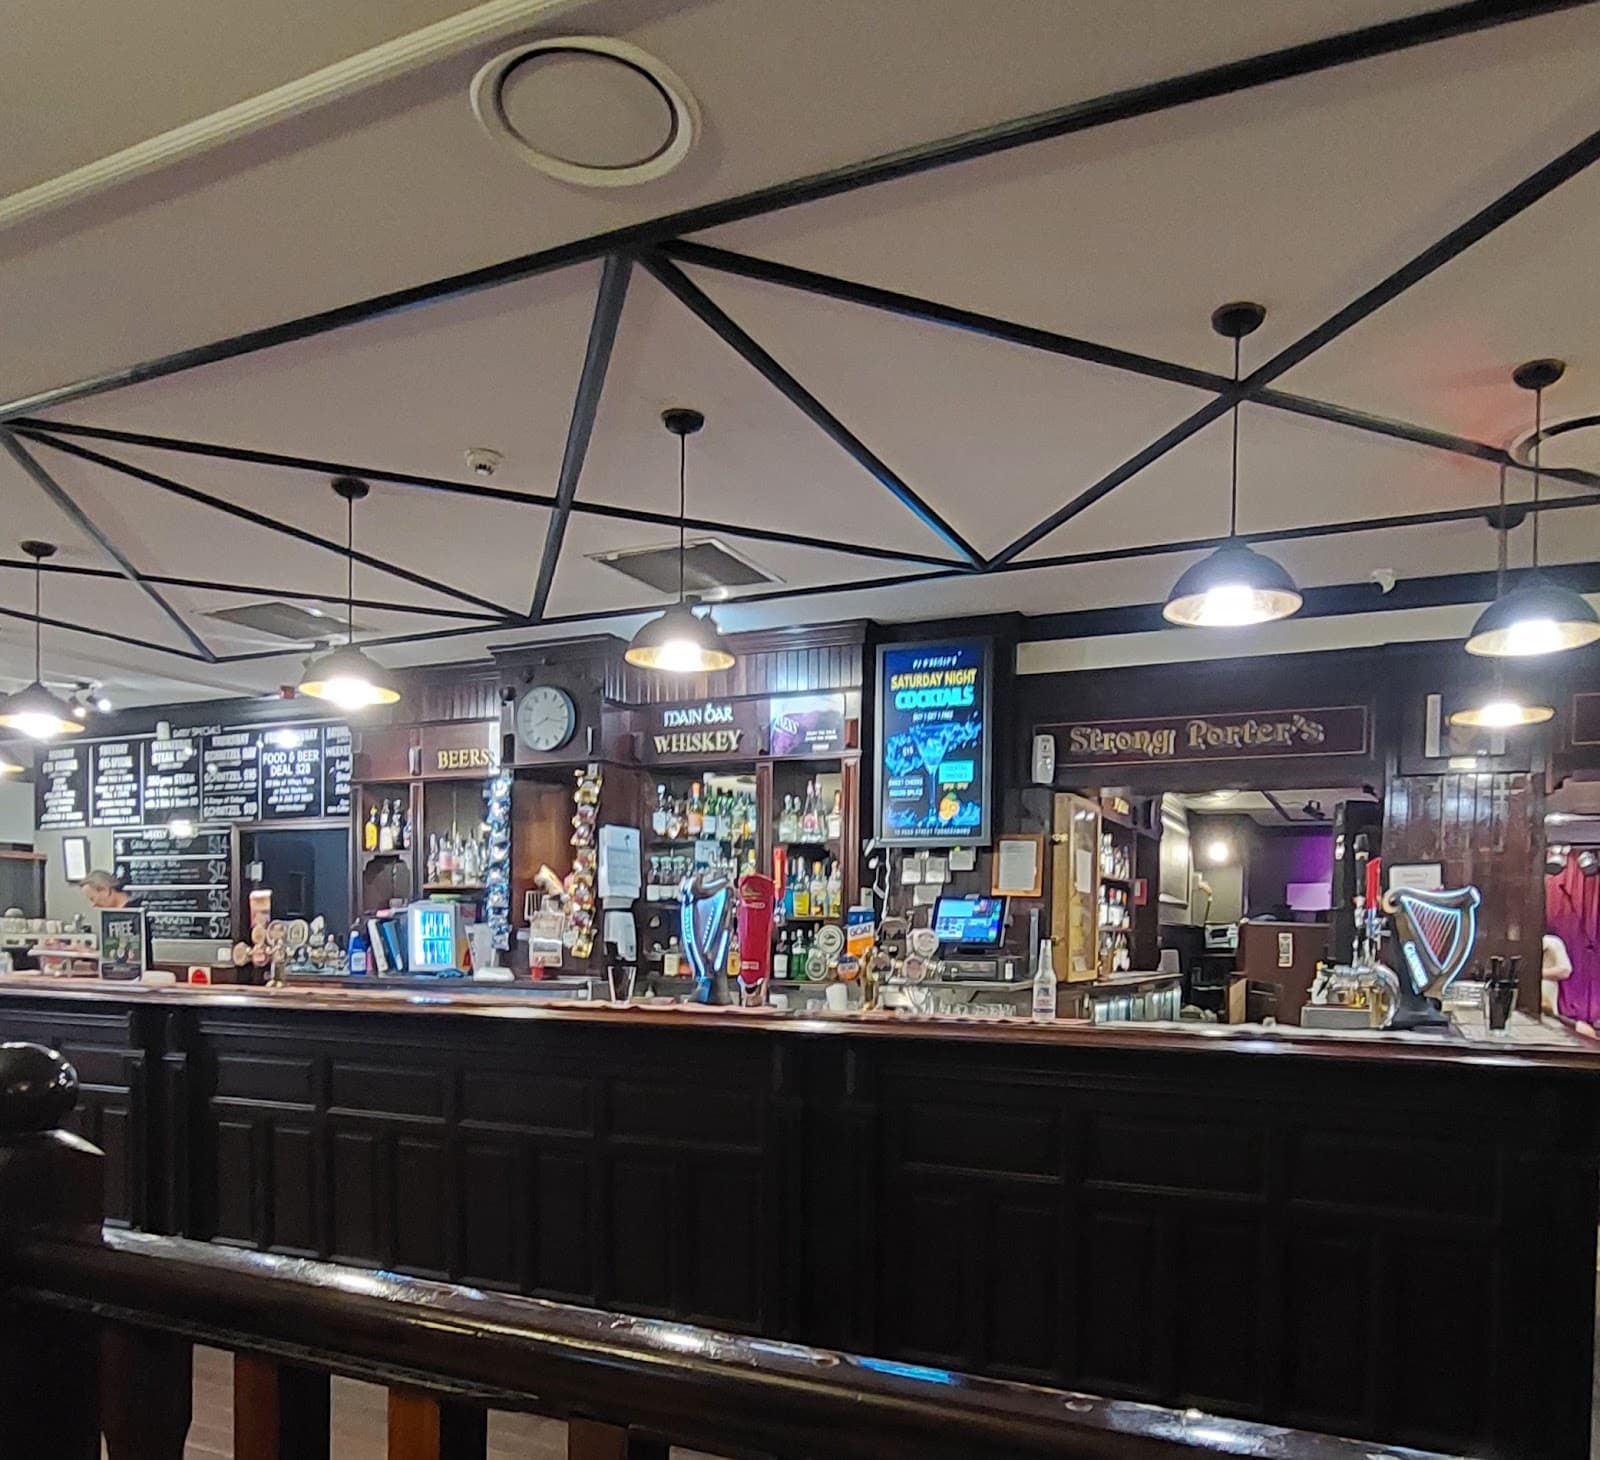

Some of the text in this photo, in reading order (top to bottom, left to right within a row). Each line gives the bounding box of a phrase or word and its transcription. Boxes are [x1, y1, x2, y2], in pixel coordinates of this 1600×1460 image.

[891, 669, 977, 691] SATURDAY NIGHT
[895, 684, 974, 710] COCKTAILS
[664, 709, 702, 727] MAIN
[653, 730, 742, 754] WHISKEY
[1070, 714, 1325, 757] Strong Porter's
[263, 752, 287, 765] FOOD
[297, 750, 319, 762] BEER
[438, 748, 489, 769] BEERS
[270, 763, 293, 778] DEAL
[108, 920, 135, 937] FREE
[850, 924, 872, 937] GOAT
